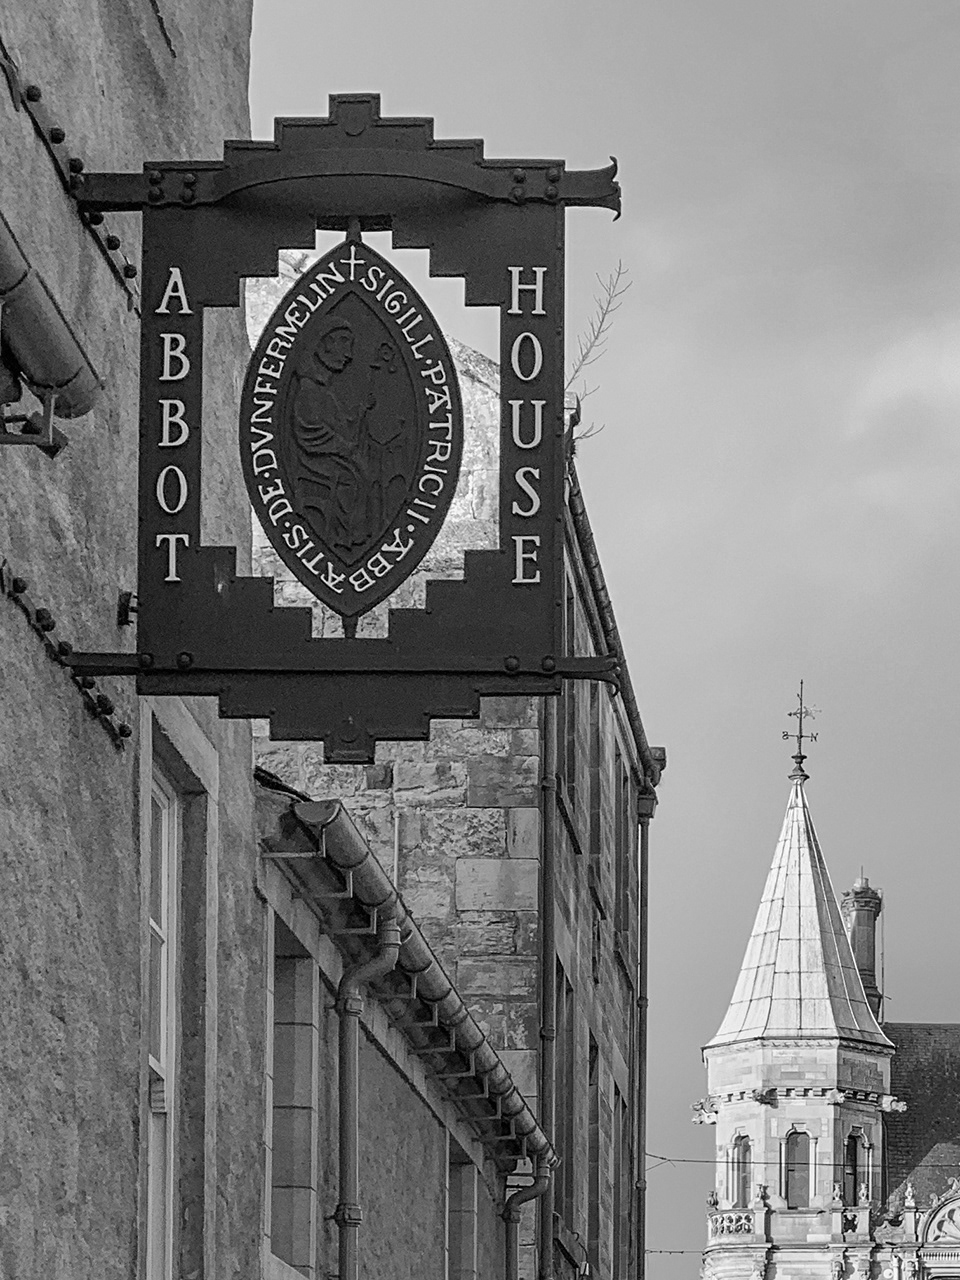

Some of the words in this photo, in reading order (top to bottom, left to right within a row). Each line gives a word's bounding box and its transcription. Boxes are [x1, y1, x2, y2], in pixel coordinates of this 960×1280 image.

[359, 265, 435, 360] SIGILL
[154, 266, 194, 582] ABBOT
[257, 478, 294, 527] DE
[506, 265, 548, 584] HOUSE
